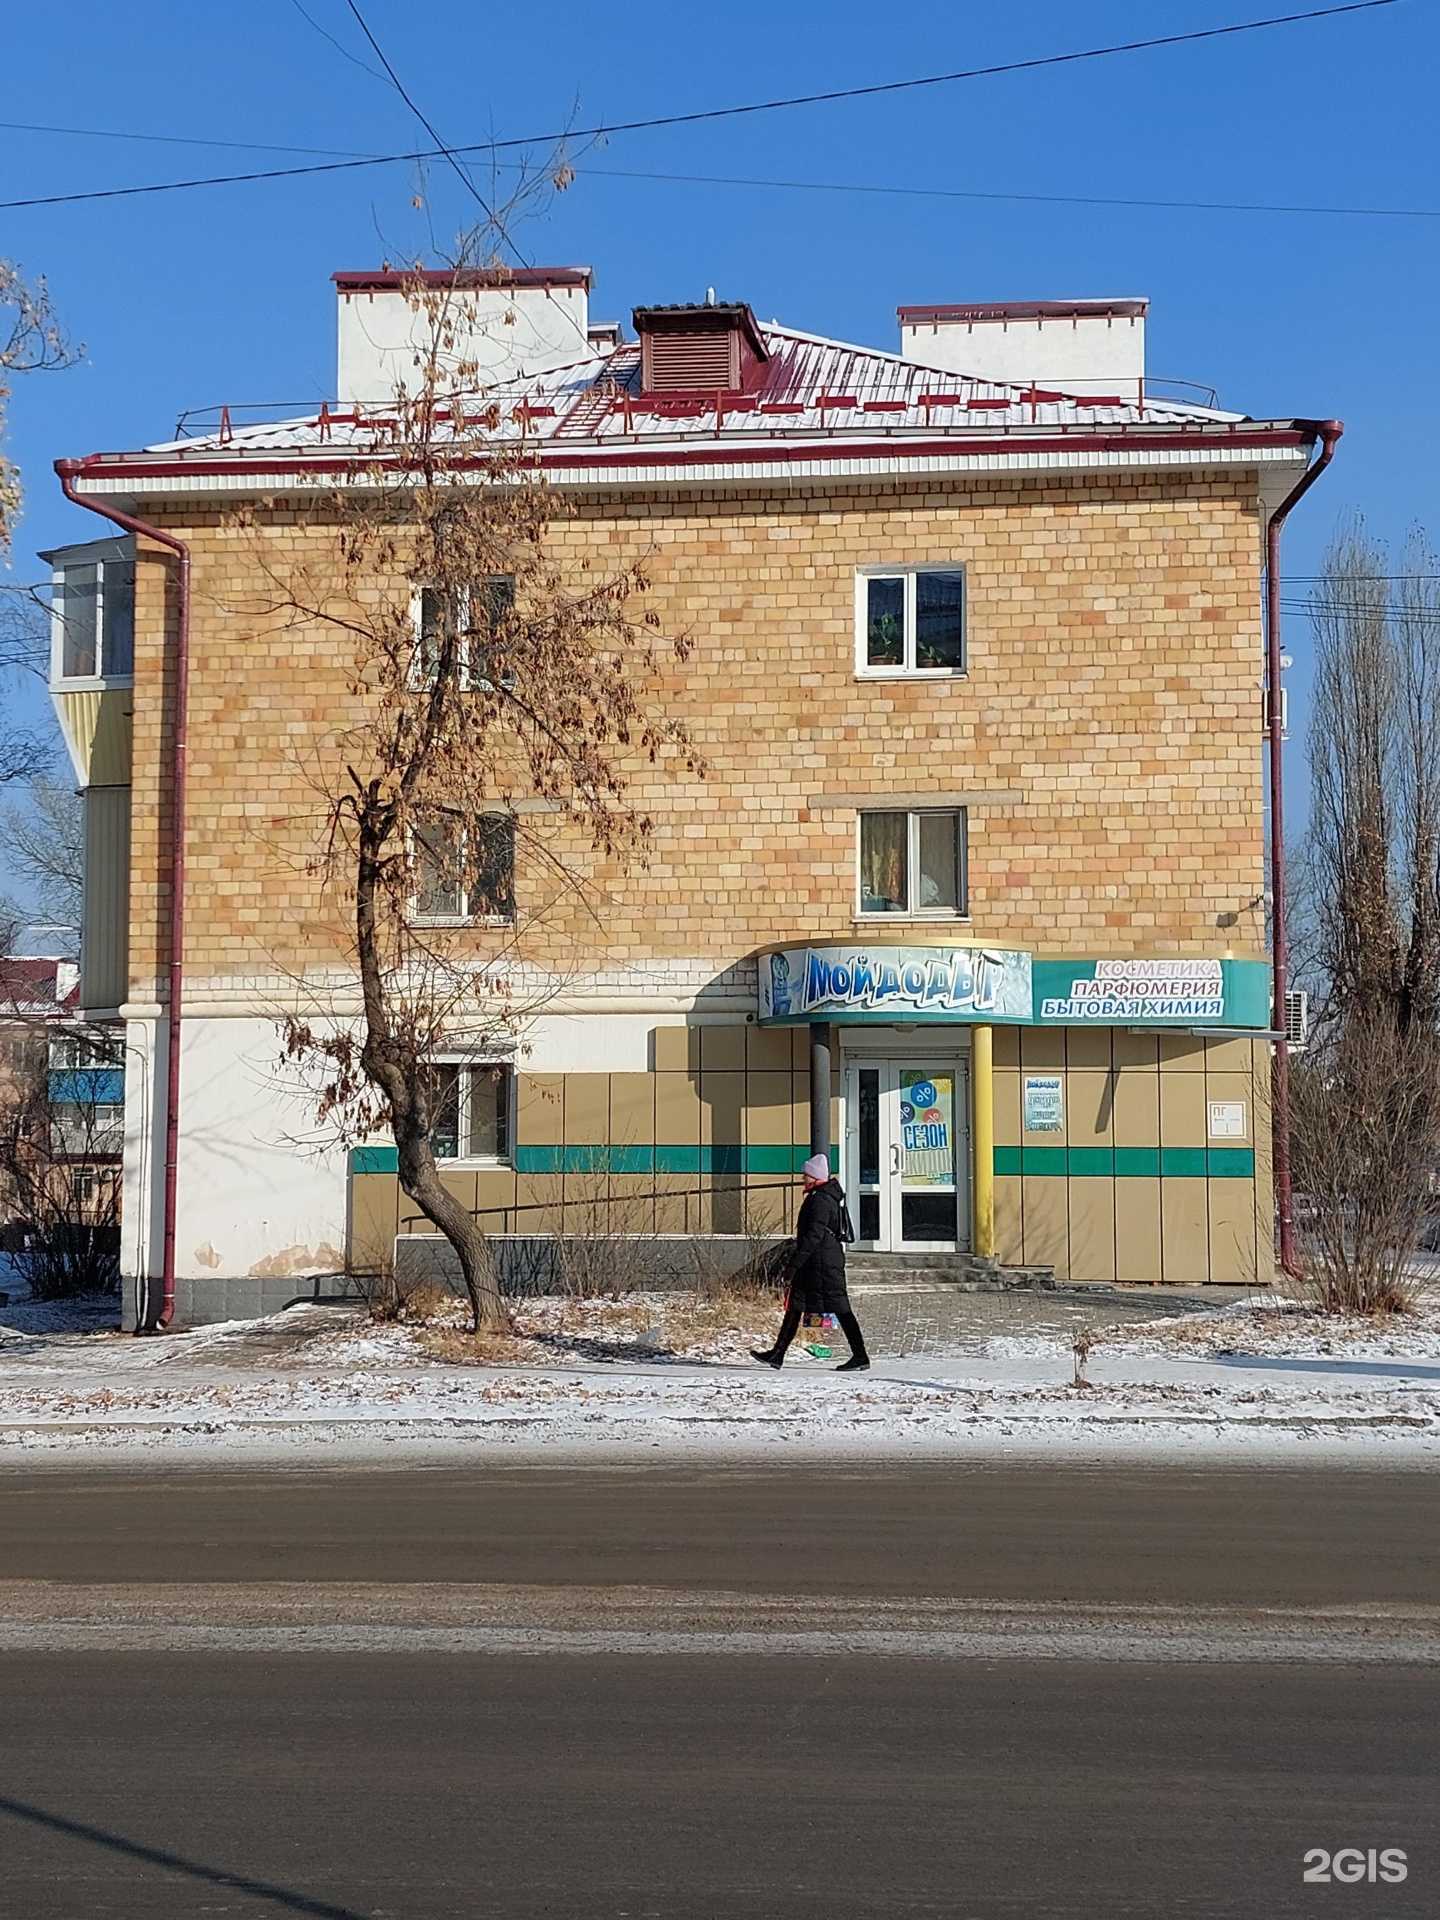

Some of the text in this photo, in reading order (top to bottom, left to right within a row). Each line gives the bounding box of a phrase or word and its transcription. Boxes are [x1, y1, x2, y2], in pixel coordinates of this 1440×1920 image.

[1098, 962, 1221, 977] КОСМЕТИКА
[1073, 981, 1220, 997] ПАРФЮМЕРИЯ
[1043, 1000, 1221, 1016] БЫТОВАЯ ХИМИЯ
[904, 1123, 948, 1149] СЕЗОН
